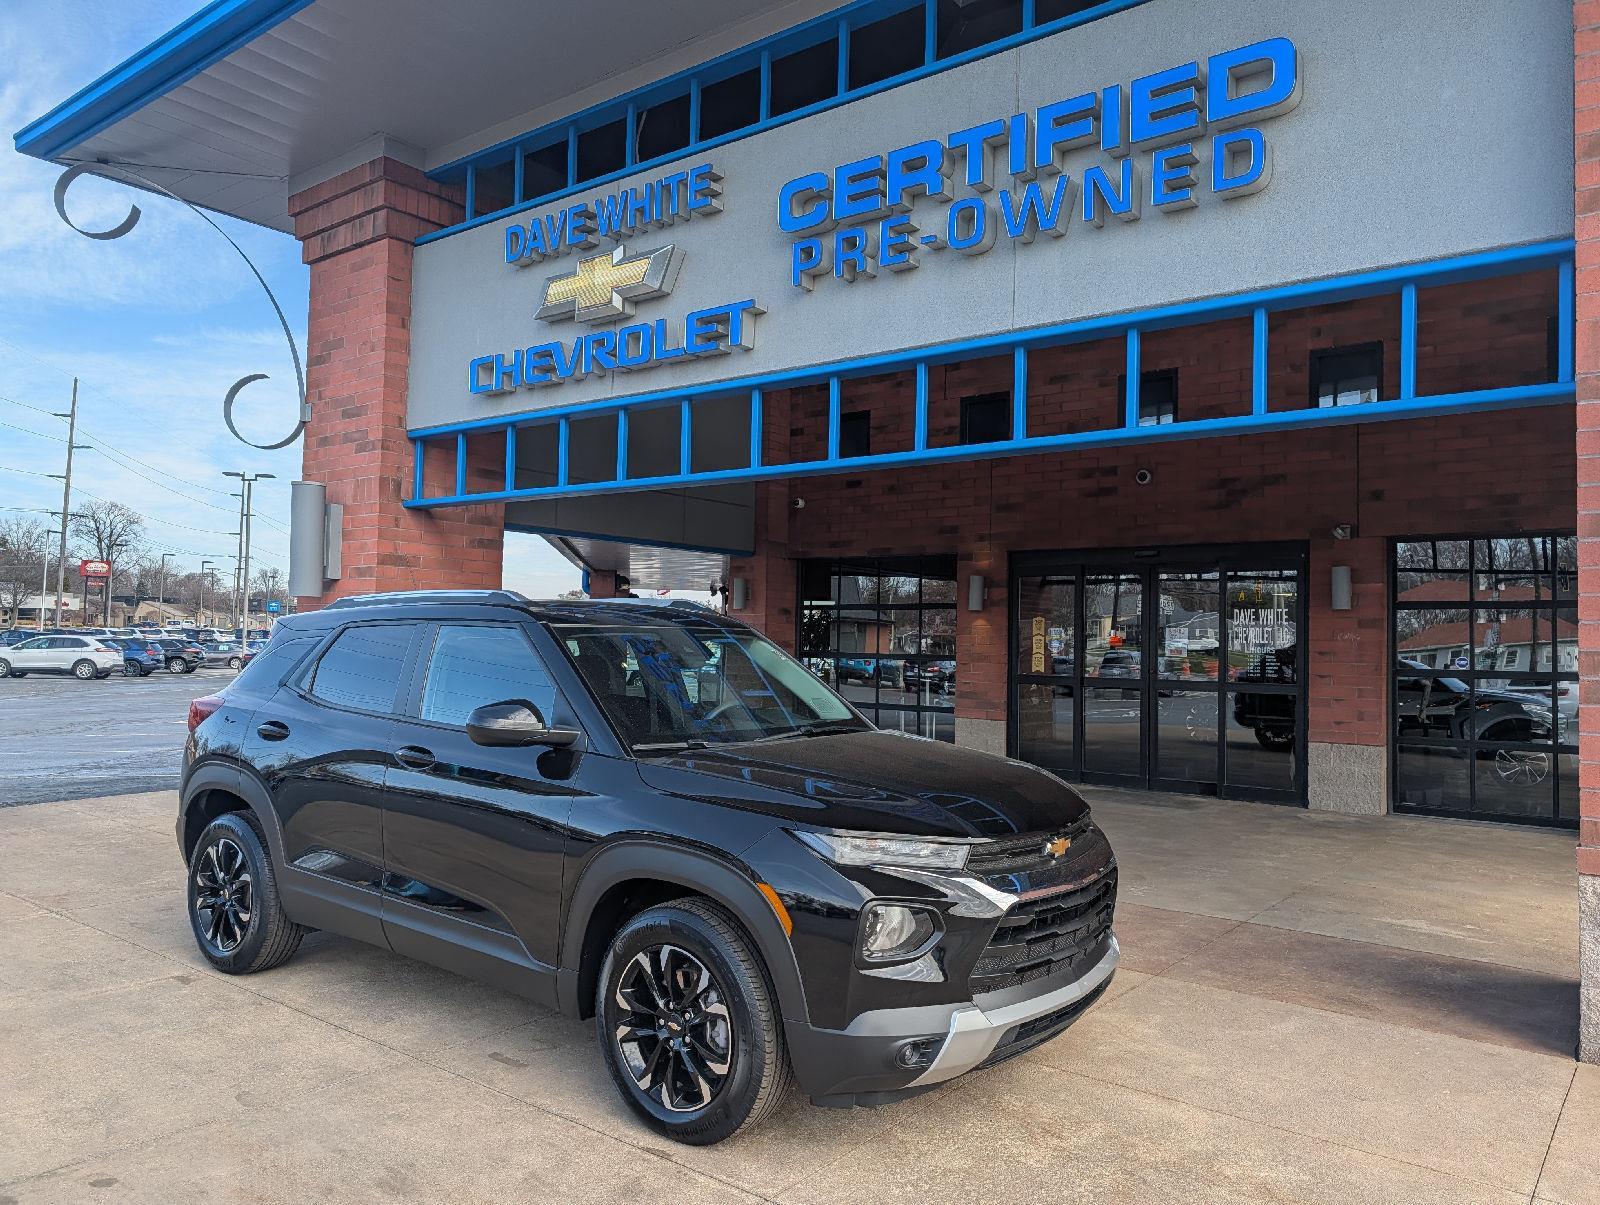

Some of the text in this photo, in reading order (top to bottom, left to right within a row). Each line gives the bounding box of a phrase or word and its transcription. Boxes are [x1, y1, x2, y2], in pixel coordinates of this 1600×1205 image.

[777, 37, 1298, 234] CERTIFIED
[504, 162, 714, 264] DAVE WHITE
[792, 127, 1267, 288] PRE-OWNED
[469, 298, 757, 395] CHEVROLET
[1233, 608, 1289, 626] DAVE WHITE
